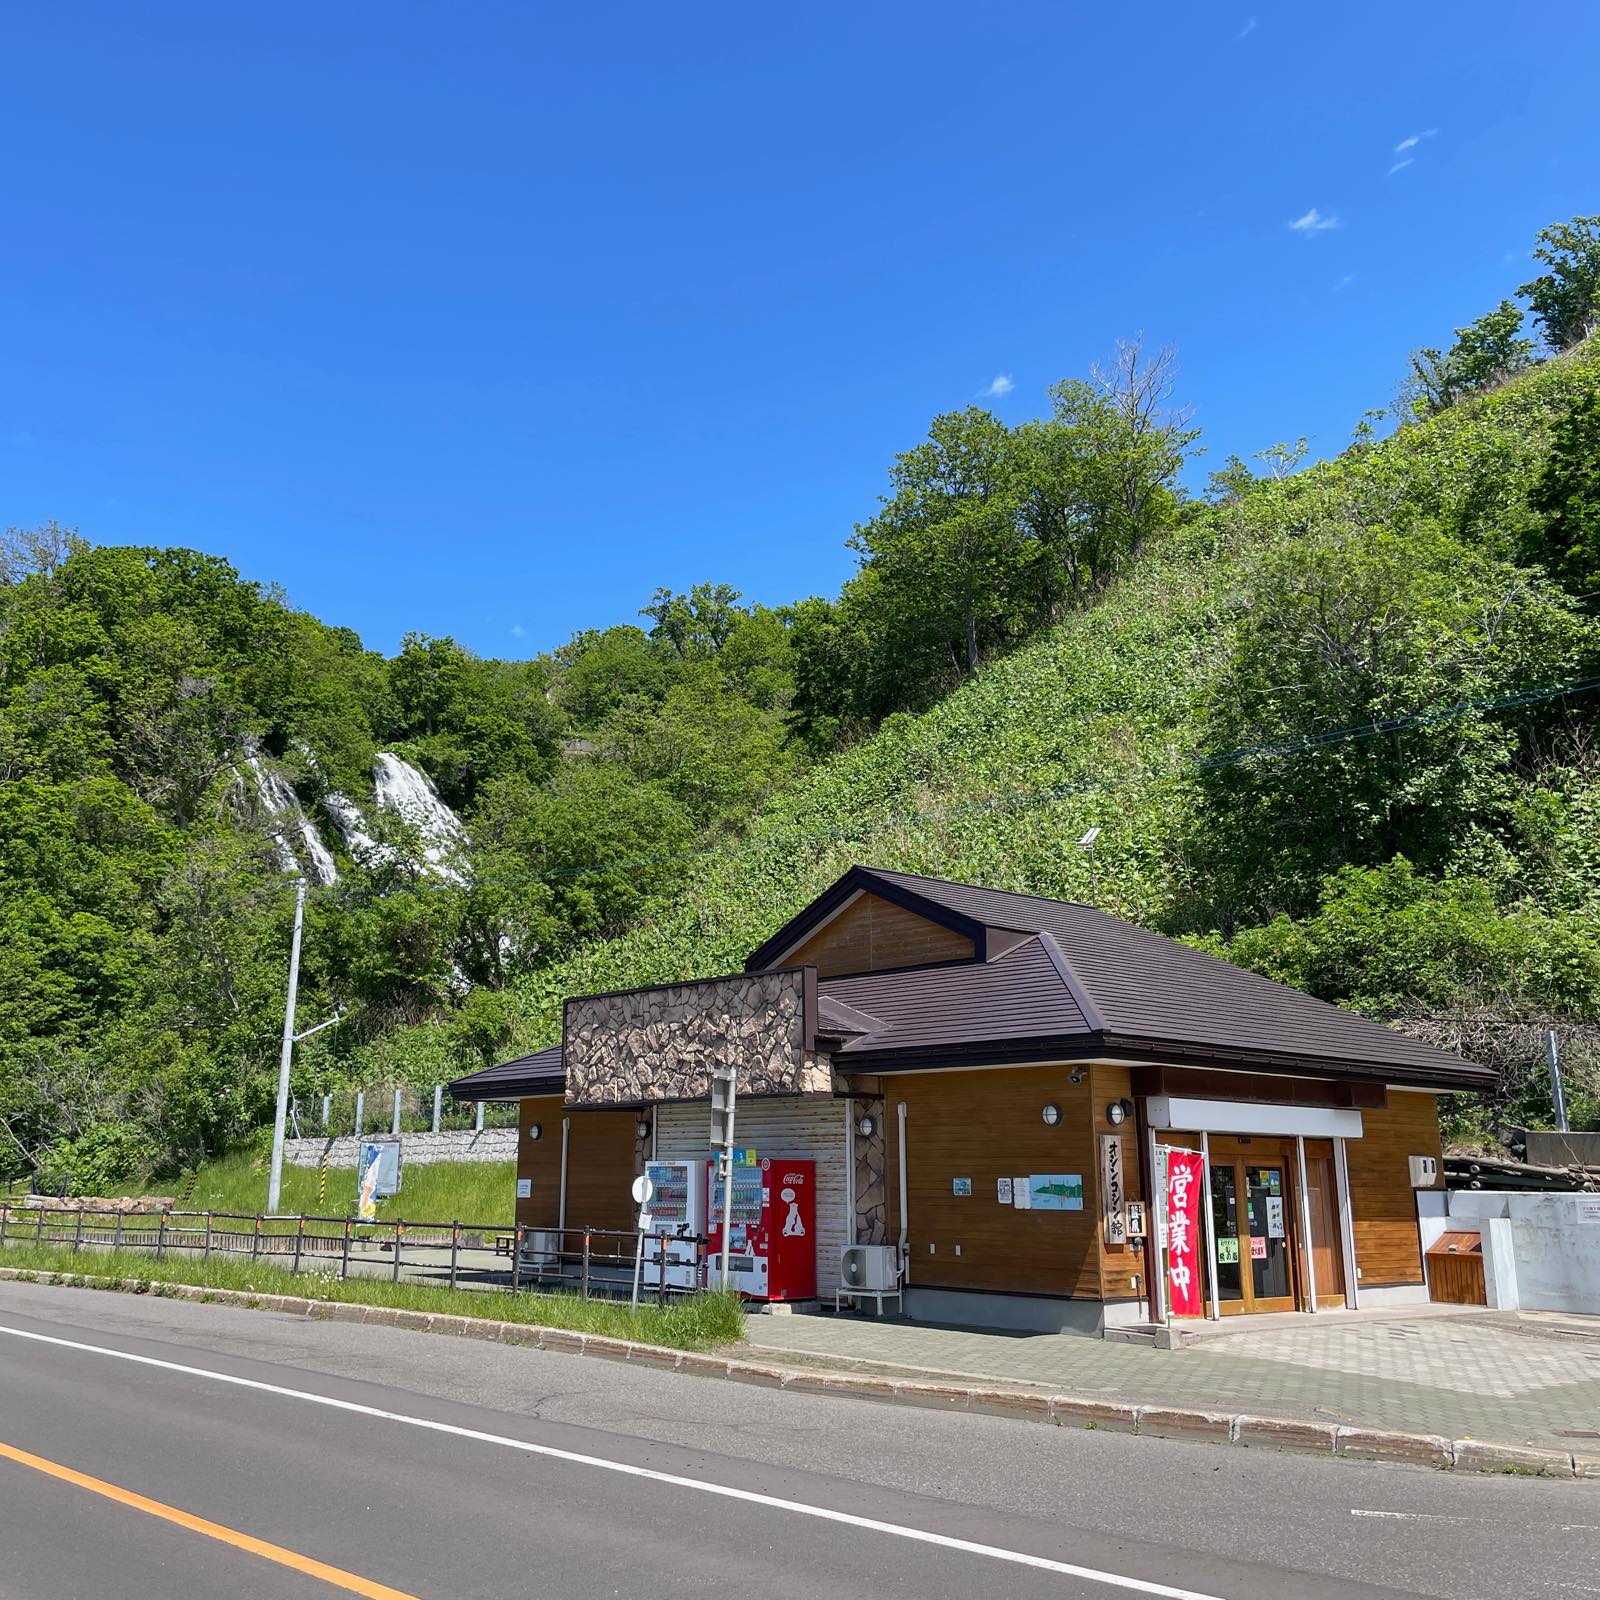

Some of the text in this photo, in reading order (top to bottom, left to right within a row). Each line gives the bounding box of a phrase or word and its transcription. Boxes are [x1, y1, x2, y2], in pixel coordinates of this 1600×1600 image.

[783, 1173, 805, 1185] Coca-Cola
[1109, 1141, 1123, 1237] オシンコシン館
[1169, 1164, 1194, 1302] 営業中
